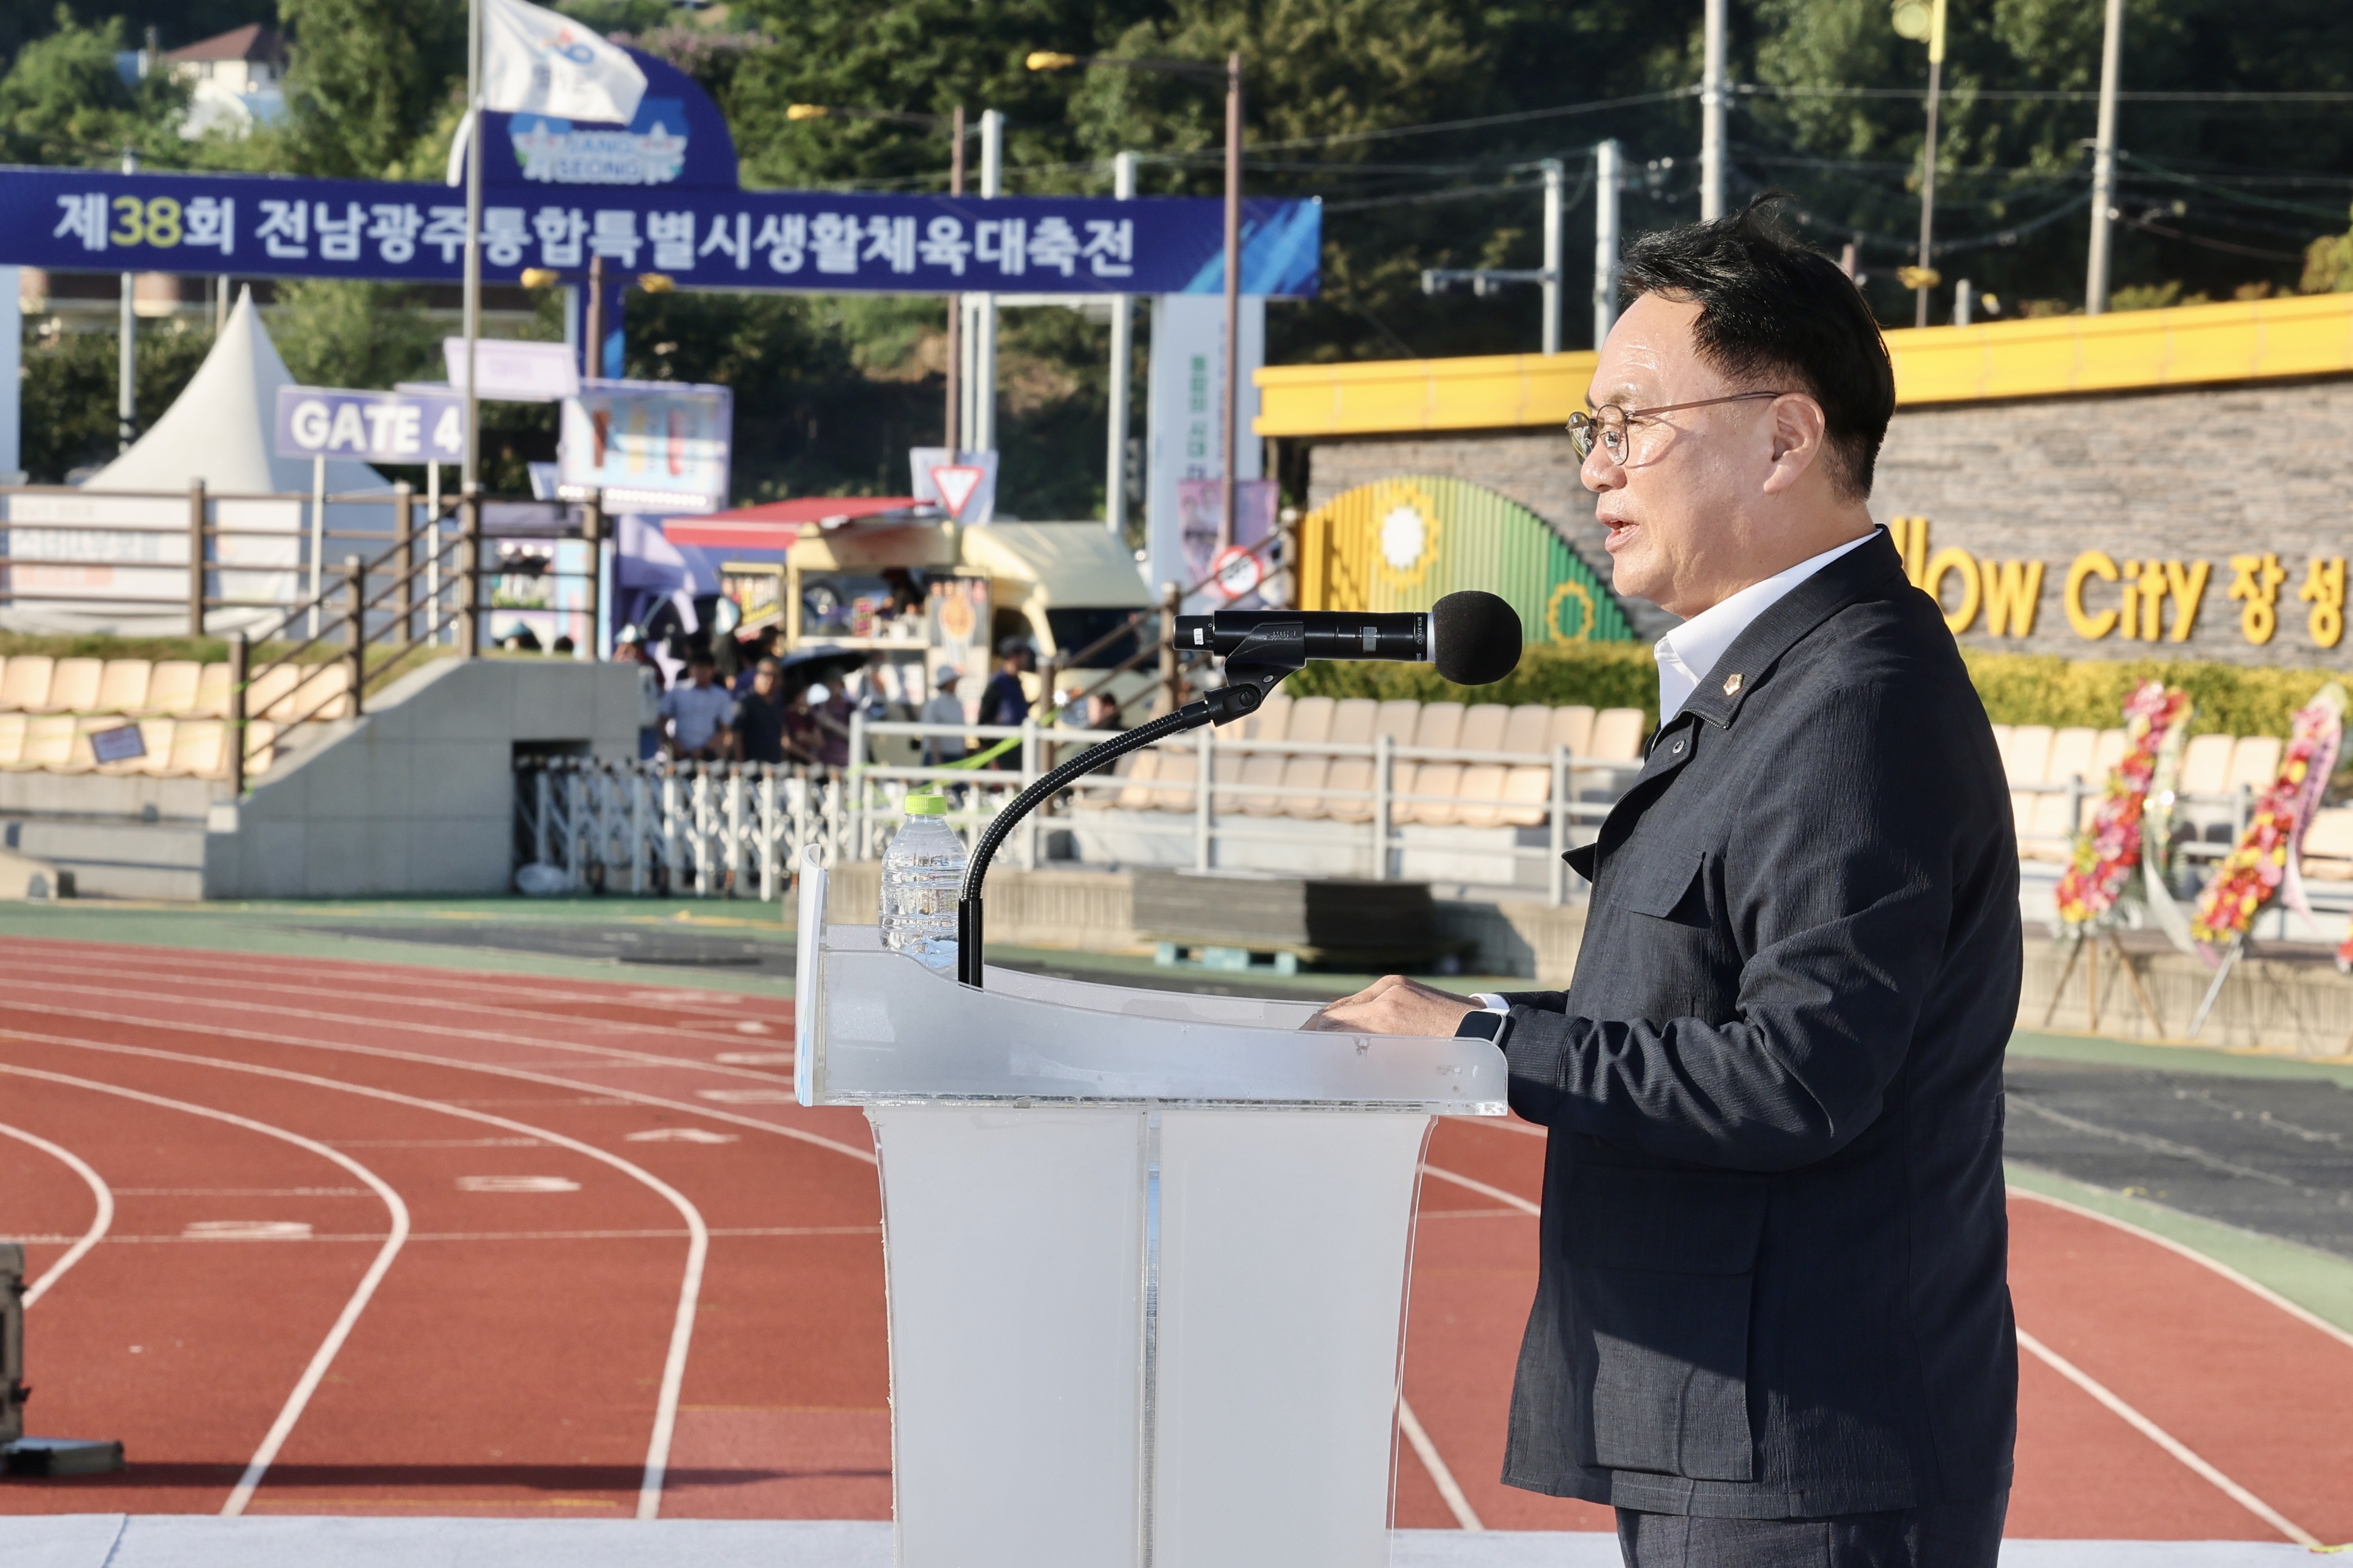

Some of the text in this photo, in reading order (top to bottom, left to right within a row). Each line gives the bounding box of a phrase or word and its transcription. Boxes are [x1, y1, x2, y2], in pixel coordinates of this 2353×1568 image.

[54, 193, 235, 256] 제38회
[291, 400, 463, 454] GATE 4
[1890, 516, 2045, 639] llow
[2065, 549, 2210, 643] City
